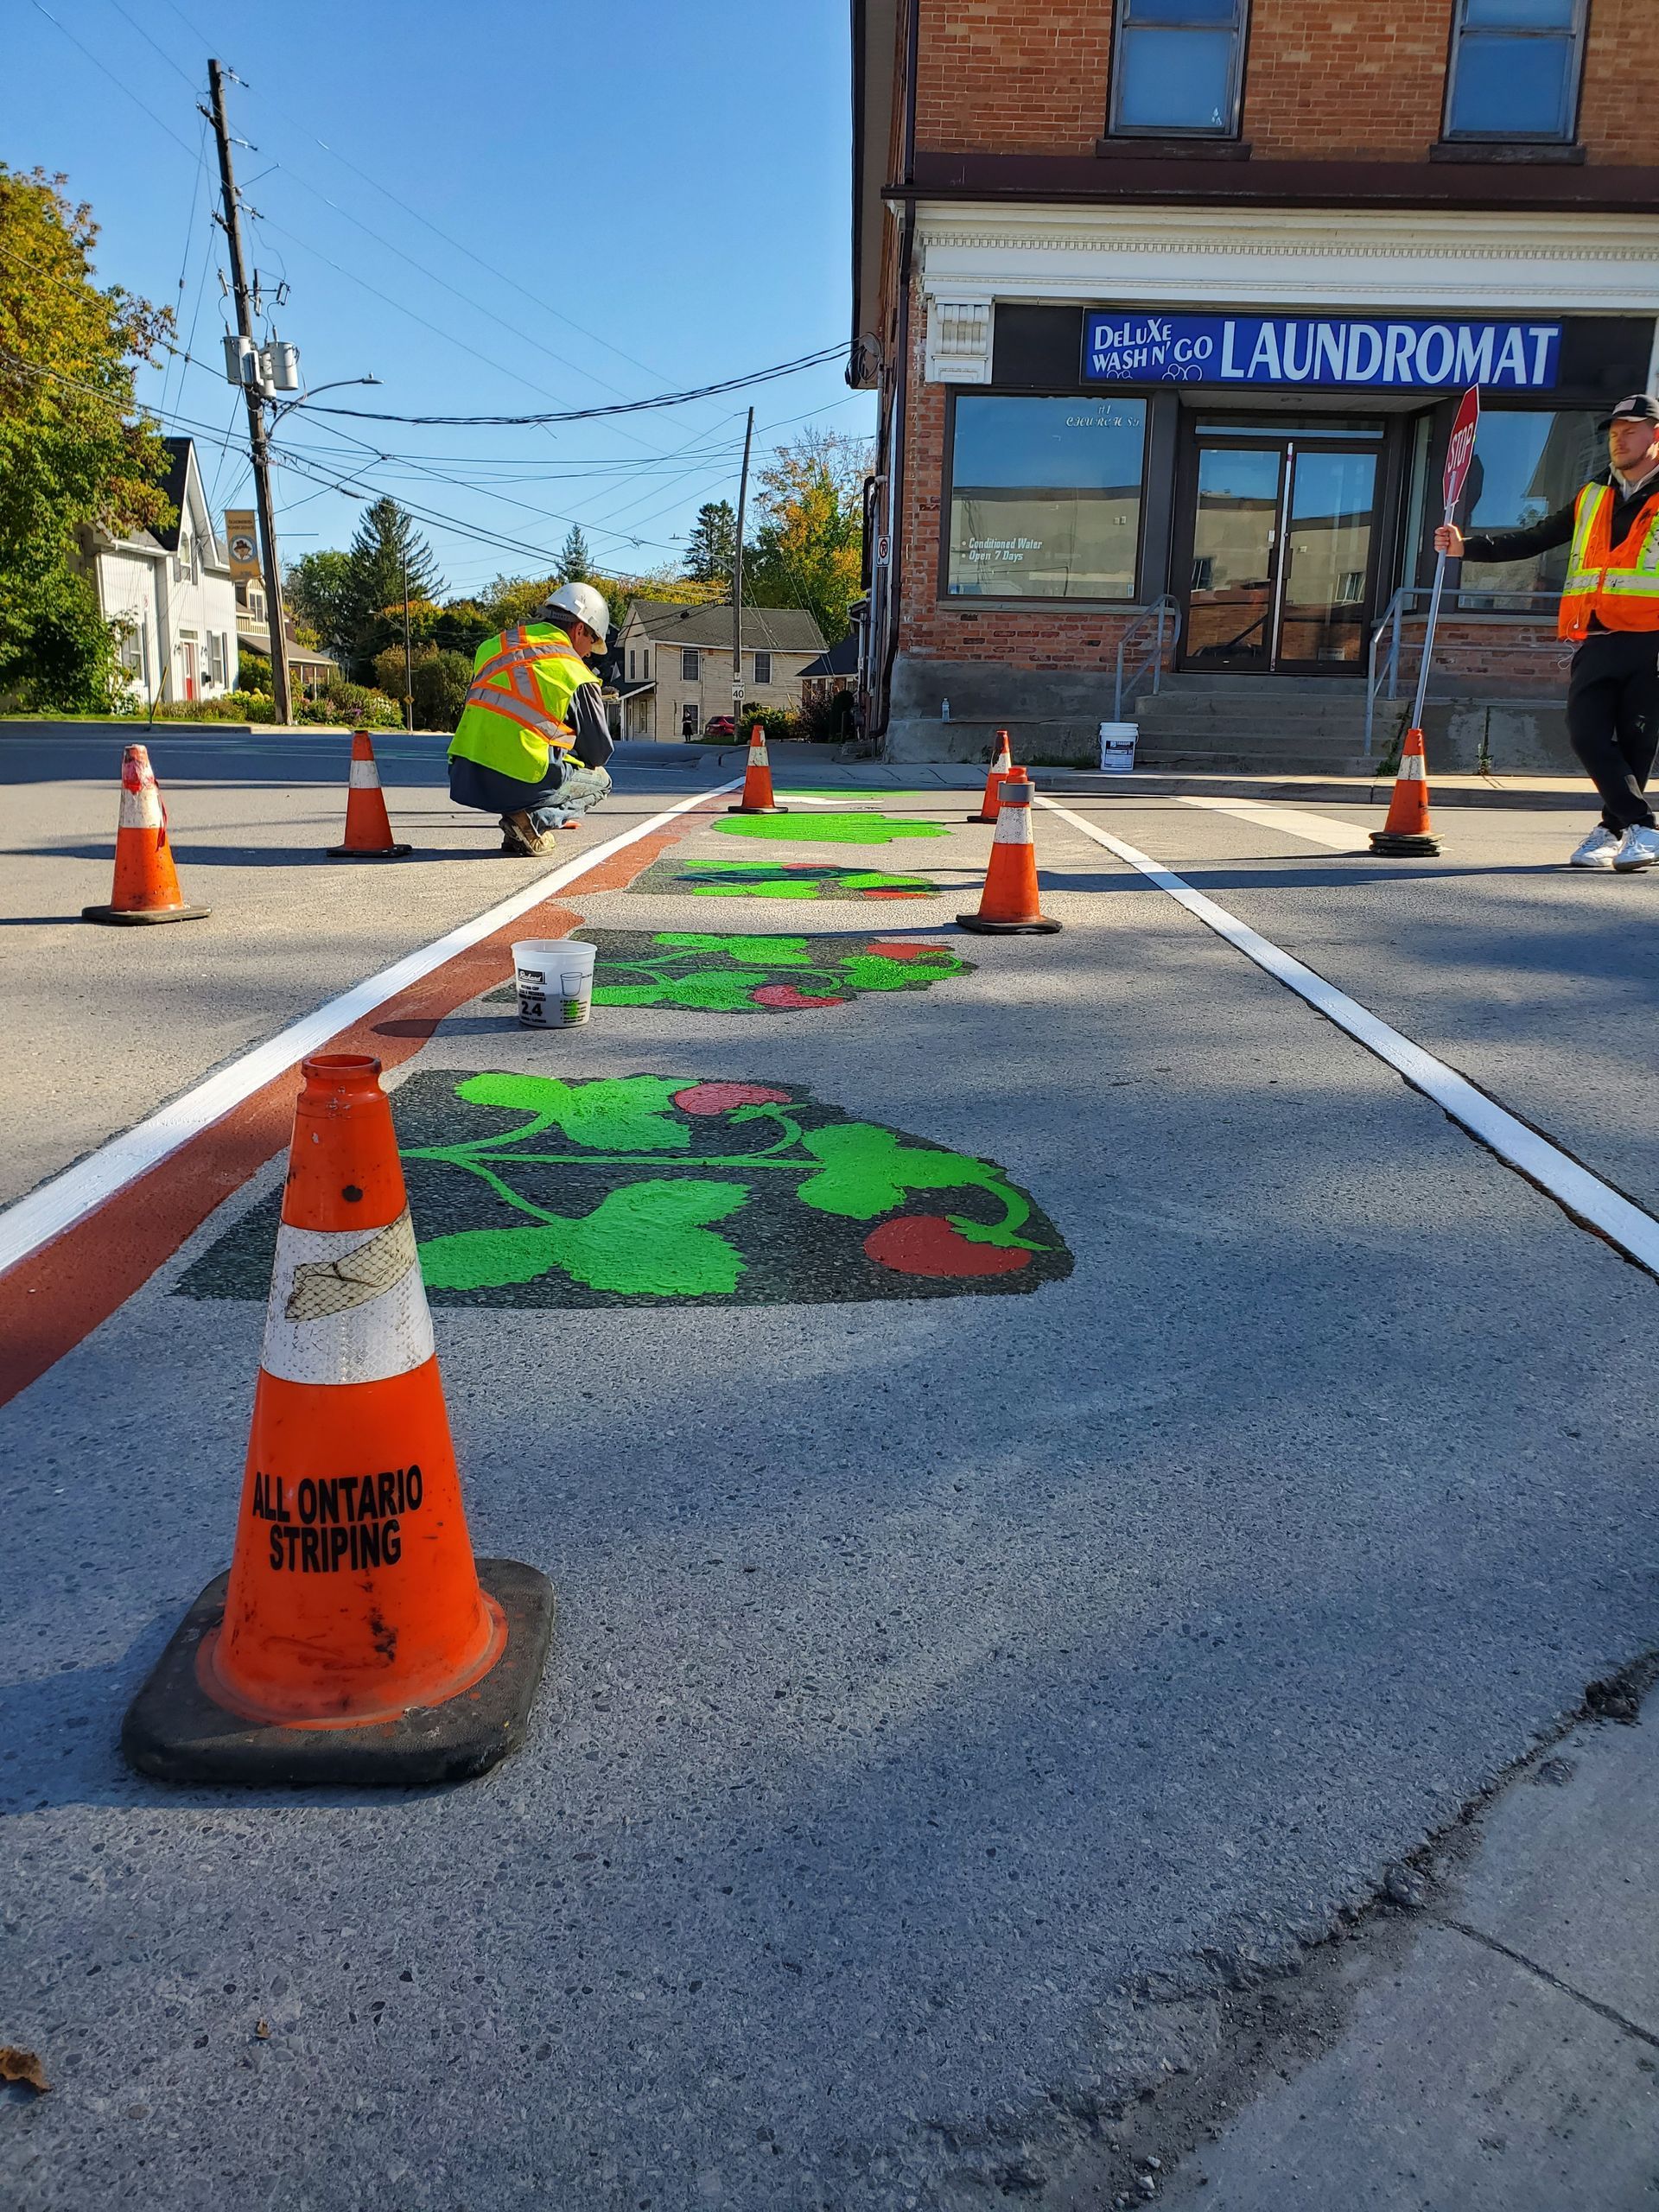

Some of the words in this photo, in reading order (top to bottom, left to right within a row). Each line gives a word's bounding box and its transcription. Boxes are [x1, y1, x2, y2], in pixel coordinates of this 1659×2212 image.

[1092, 347, 1147, 373] WASH
[1173, 335, 1213, 362] GO
[1220, 321, 1559, 385] LAUNDROMAT
[1447, 422, 1474, 474] STOP
[969, 538, 1016, 550] Conditioned
[1018, 538, 1043, 550] Water
[969, 550, 991, 562] Open
[995, 550, 1001, 560] 7
[1002, 550, 1023, 563] Days
[521, 1001, 543, 1016] 2.4
[252, 1471, 290, 1522] ALL
[298, 1465, 423, 1524] ONTARIO
[270, 1519, 402, 1573] STRIPING
